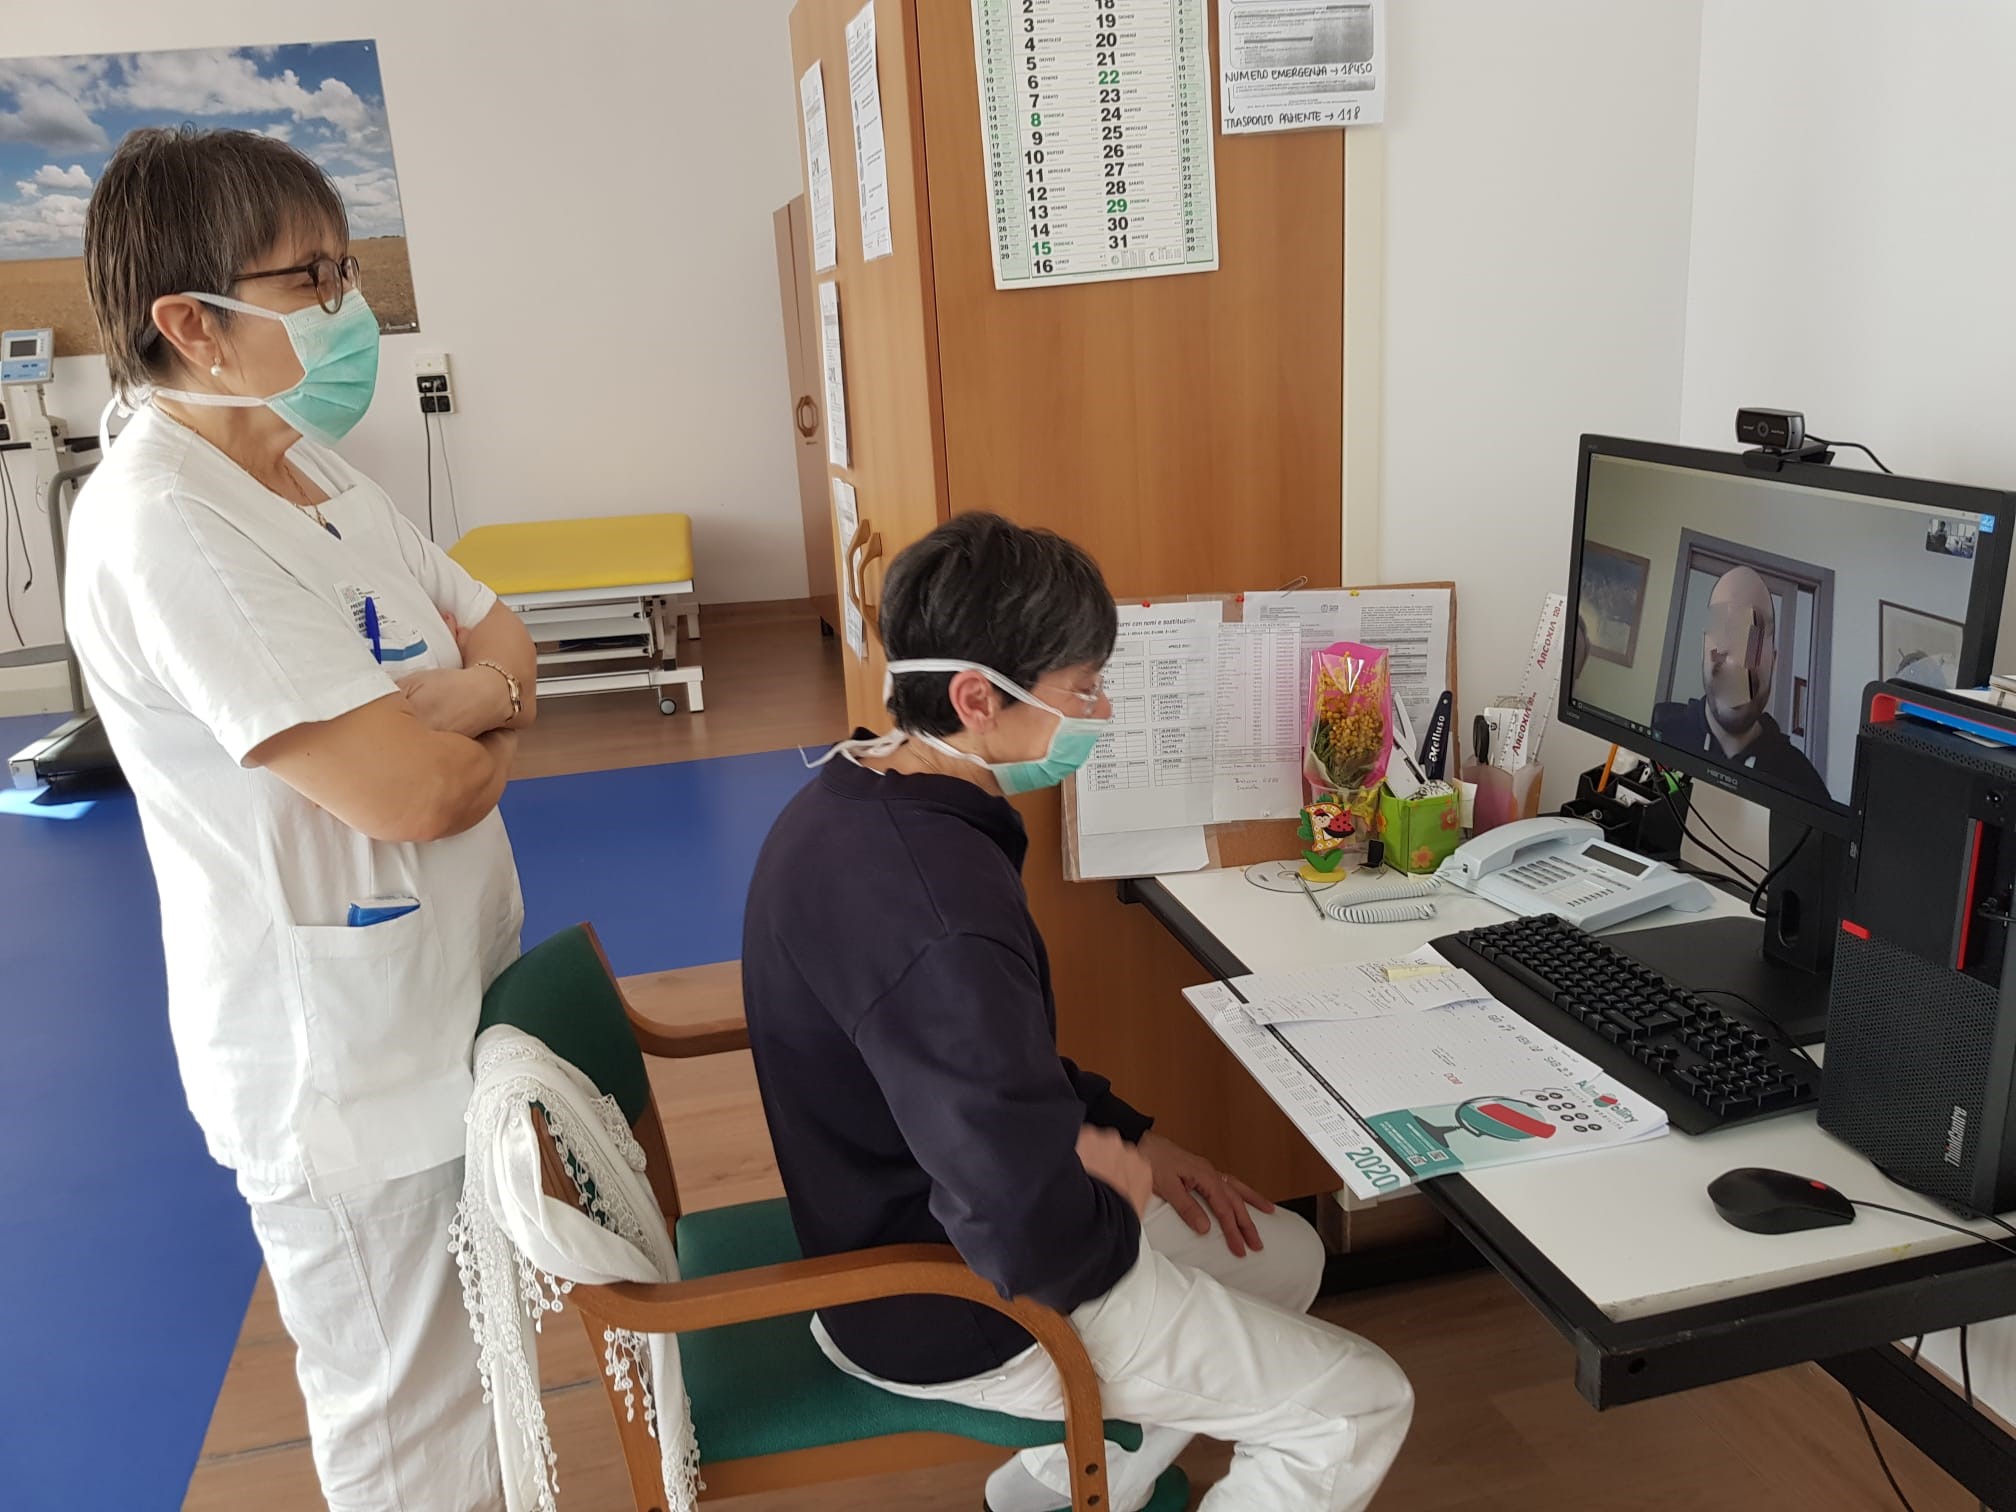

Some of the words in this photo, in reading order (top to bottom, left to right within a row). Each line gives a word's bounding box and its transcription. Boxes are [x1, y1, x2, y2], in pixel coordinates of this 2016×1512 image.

[1023, 0, 1034, 14] 2
[1096, 0, 1115, 10] 18
[1024, 18, 1034, 33] 3
[1096, 14, 1116, 28] 19
[1024, 37, 1036, 52] 4
[1095, 33, 1117, 48] 20
[1026, 56, 1037, 71] 5
[1097, 51, 1116, 66] 21
[1027, 75, 1039, 89] 6
[1098, 70, 1120, 85] 22
[1225, 67, 1268, 83] NUMERO
[1029, 94, 1039, 108] 7
[1099, 88, 1121, 104] 23
[1030, 112, 1042, 127] 8
[1100, 107, 1122, 122] 24
[1338, 106, 1361, 121] 118
[1031, 131, 1043, 146] 9
[1102, 125, 1123, 140] 25
[1024, 150, 1045, 165] 10
[1103, 144, 1124, 159] 26
[1026, 168, 1044, 183] 11
[1104, 162, 1125, 177] 27
[1027, 187, 1048, 202] 12
[1105, 180, 1126, 195] 28
[1029, 205, 1049, 220] 13
[1107, 198, 1128, 214] 29
[1030, 223, 1050, 238] 14
[1107, 216, 1129, 232] 30
[1032, 241, 1052, 256] 15
[1108, 234, 1127, 249] 31
[1033, 259, 1053, 274] 16
[1537, 621, 1557, 670] ARCOXIA
[1428, 715, 1446, 763] Melluso
[1513, 707, 1532, 756] ARCOXIA
[1944, 1104, 1968, 1168] ThinkCentre
[1346, 1147, 1400, 1189] 2020
